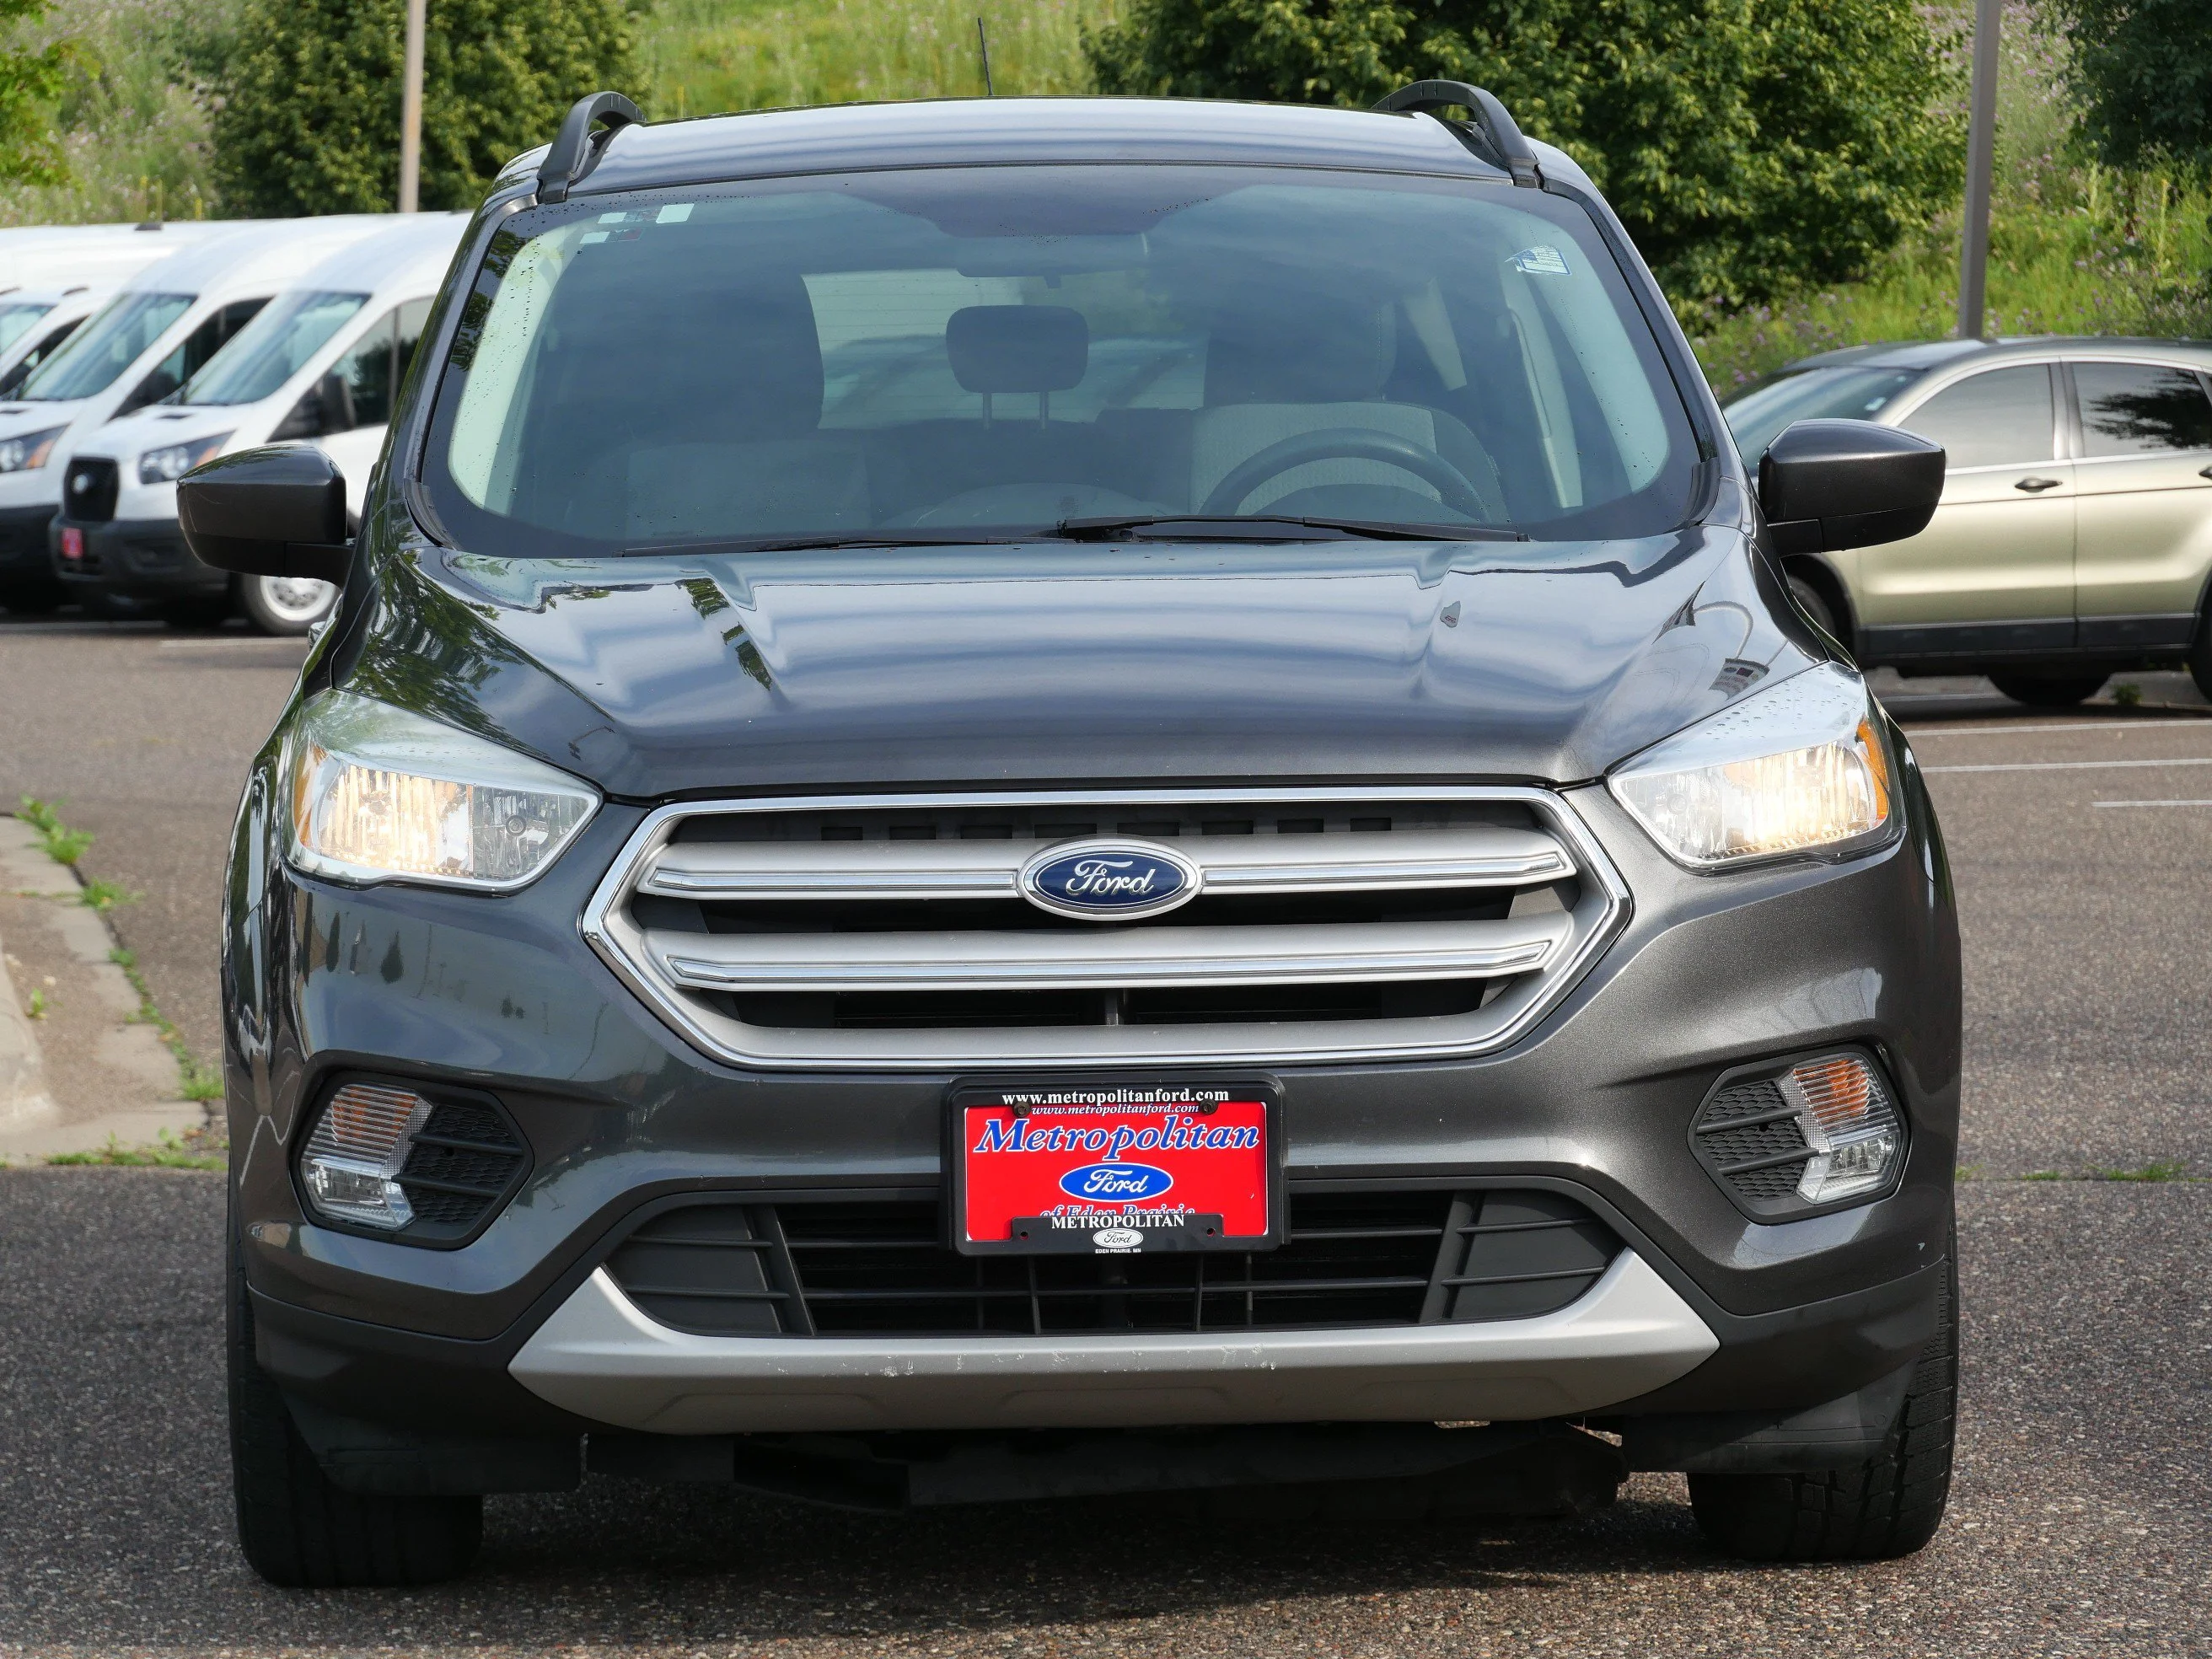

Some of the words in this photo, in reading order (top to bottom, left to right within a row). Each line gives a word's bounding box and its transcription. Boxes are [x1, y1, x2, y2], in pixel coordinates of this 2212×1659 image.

[1066, 859, 1156, 896] Ford
[1002, 1088, 1229, 1106] www.metropolitanford.com
[1031, 1102, 1200, 1117] www.metropolitanford.com
[973, 1114, 1259, 1161] Metropolitan
[1083, 1168, 1148, 1194] Ford
[1052, 1214, 1184, 1229] METROPOLITAN
[1103, 1231, 1132, 1243] Ford
